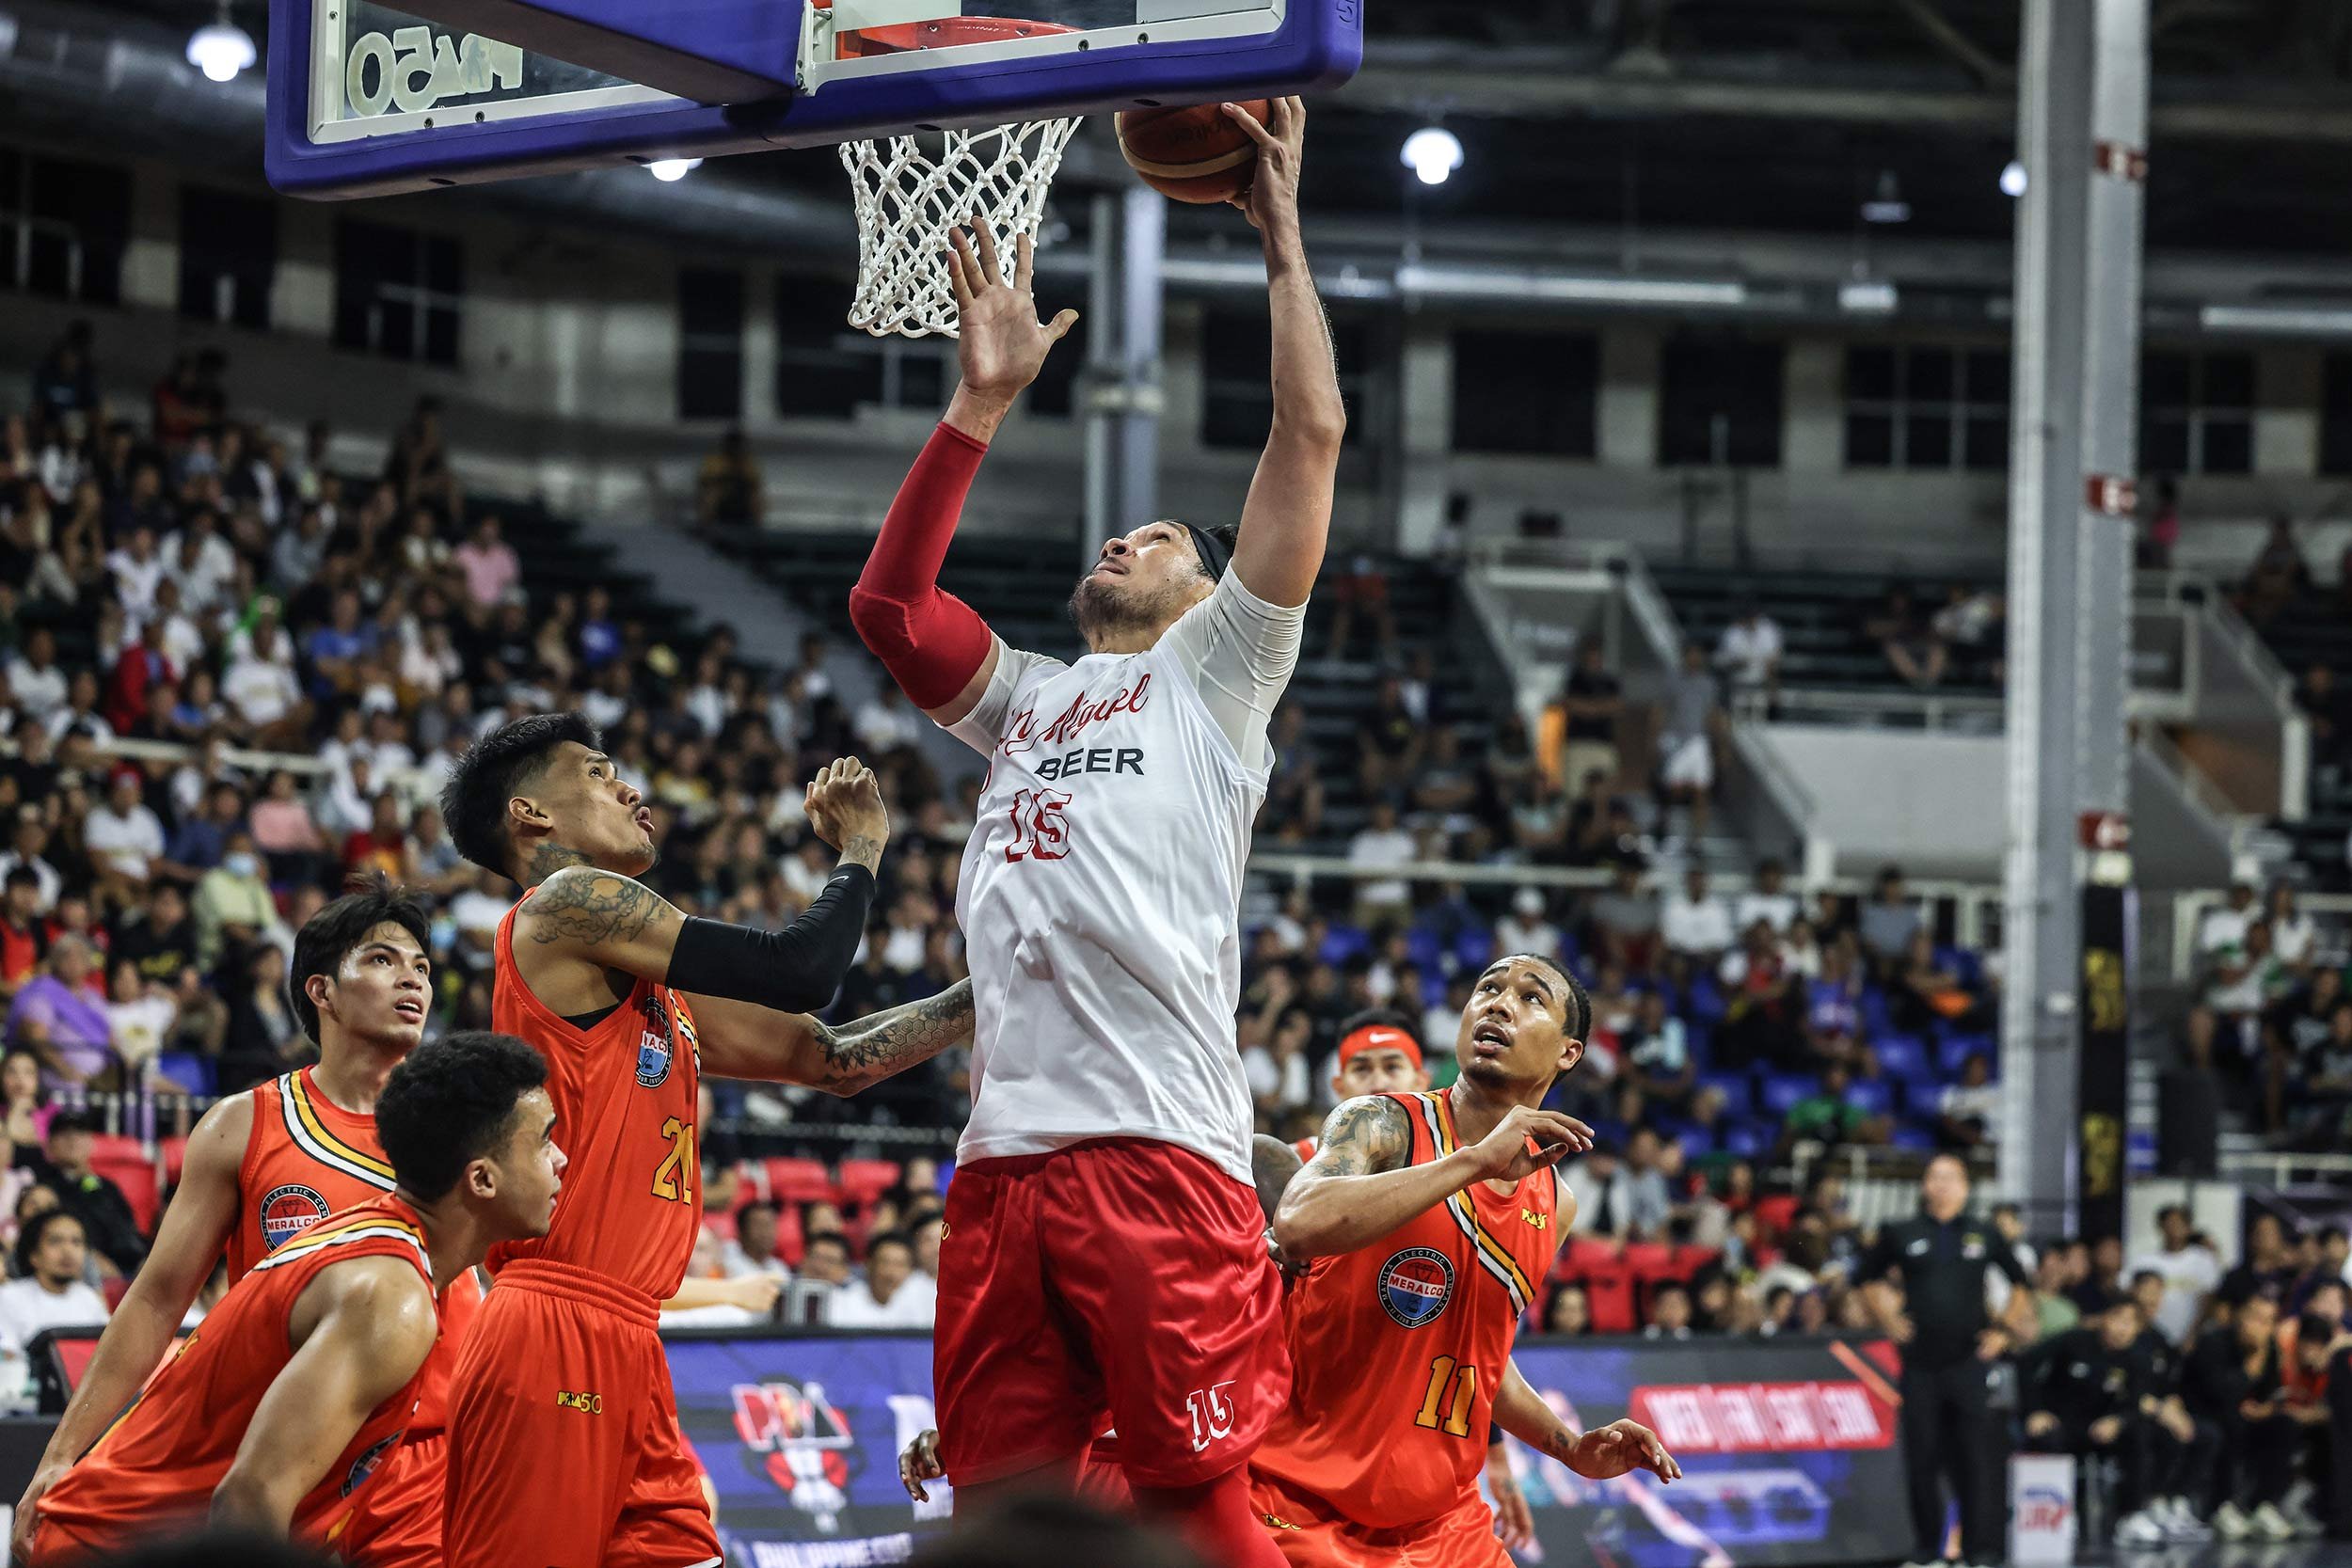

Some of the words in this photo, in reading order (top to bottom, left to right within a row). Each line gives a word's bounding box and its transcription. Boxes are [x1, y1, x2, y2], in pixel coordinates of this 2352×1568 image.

[1033, 747, 1145, 782] BEER
[1004, 788, 1073, 863] 15
[1398, 1250, 1446, 1265] ELECTRIC
[1389, 1275, 1444, 1296] MERALCO
[1185, 1379, 1237, 1452] 15
[1414, 1354, 1476, 1439] 11
